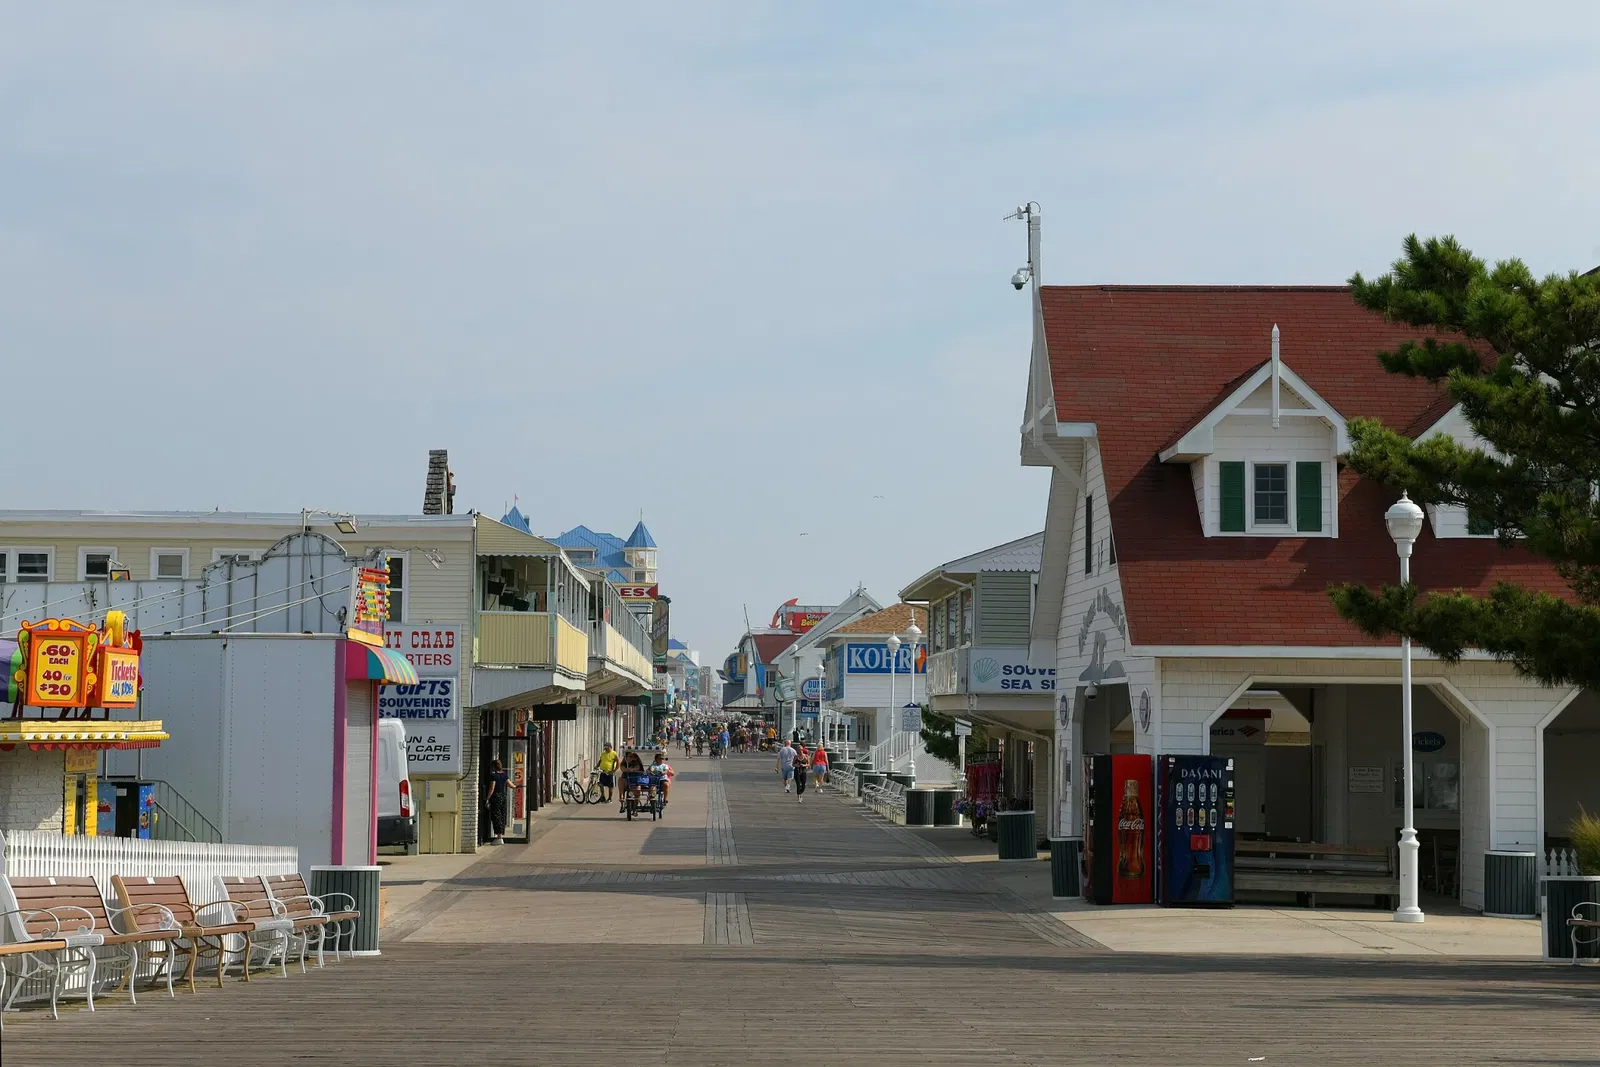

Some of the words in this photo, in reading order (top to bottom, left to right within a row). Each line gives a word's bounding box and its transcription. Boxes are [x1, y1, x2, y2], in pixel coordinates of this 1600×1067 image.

[620, 588, 645, 596] ES
[411, 631, 455, 648] CRAB
[42, 670, 62, 681] 40
[111, 659, 137, 681] Tickets
[40, 683, 71, 696] $20
[396, 680, 452, 696] GIFTS
[1000, 679, 1032, 690] SEA
[379, 698, 451, 708] SOUVENIRS
[391, 709, 450, 719] JEWELRY
[415, 745, 451, 753] CARE
[1181, 768, 1222, 779] DASANI
